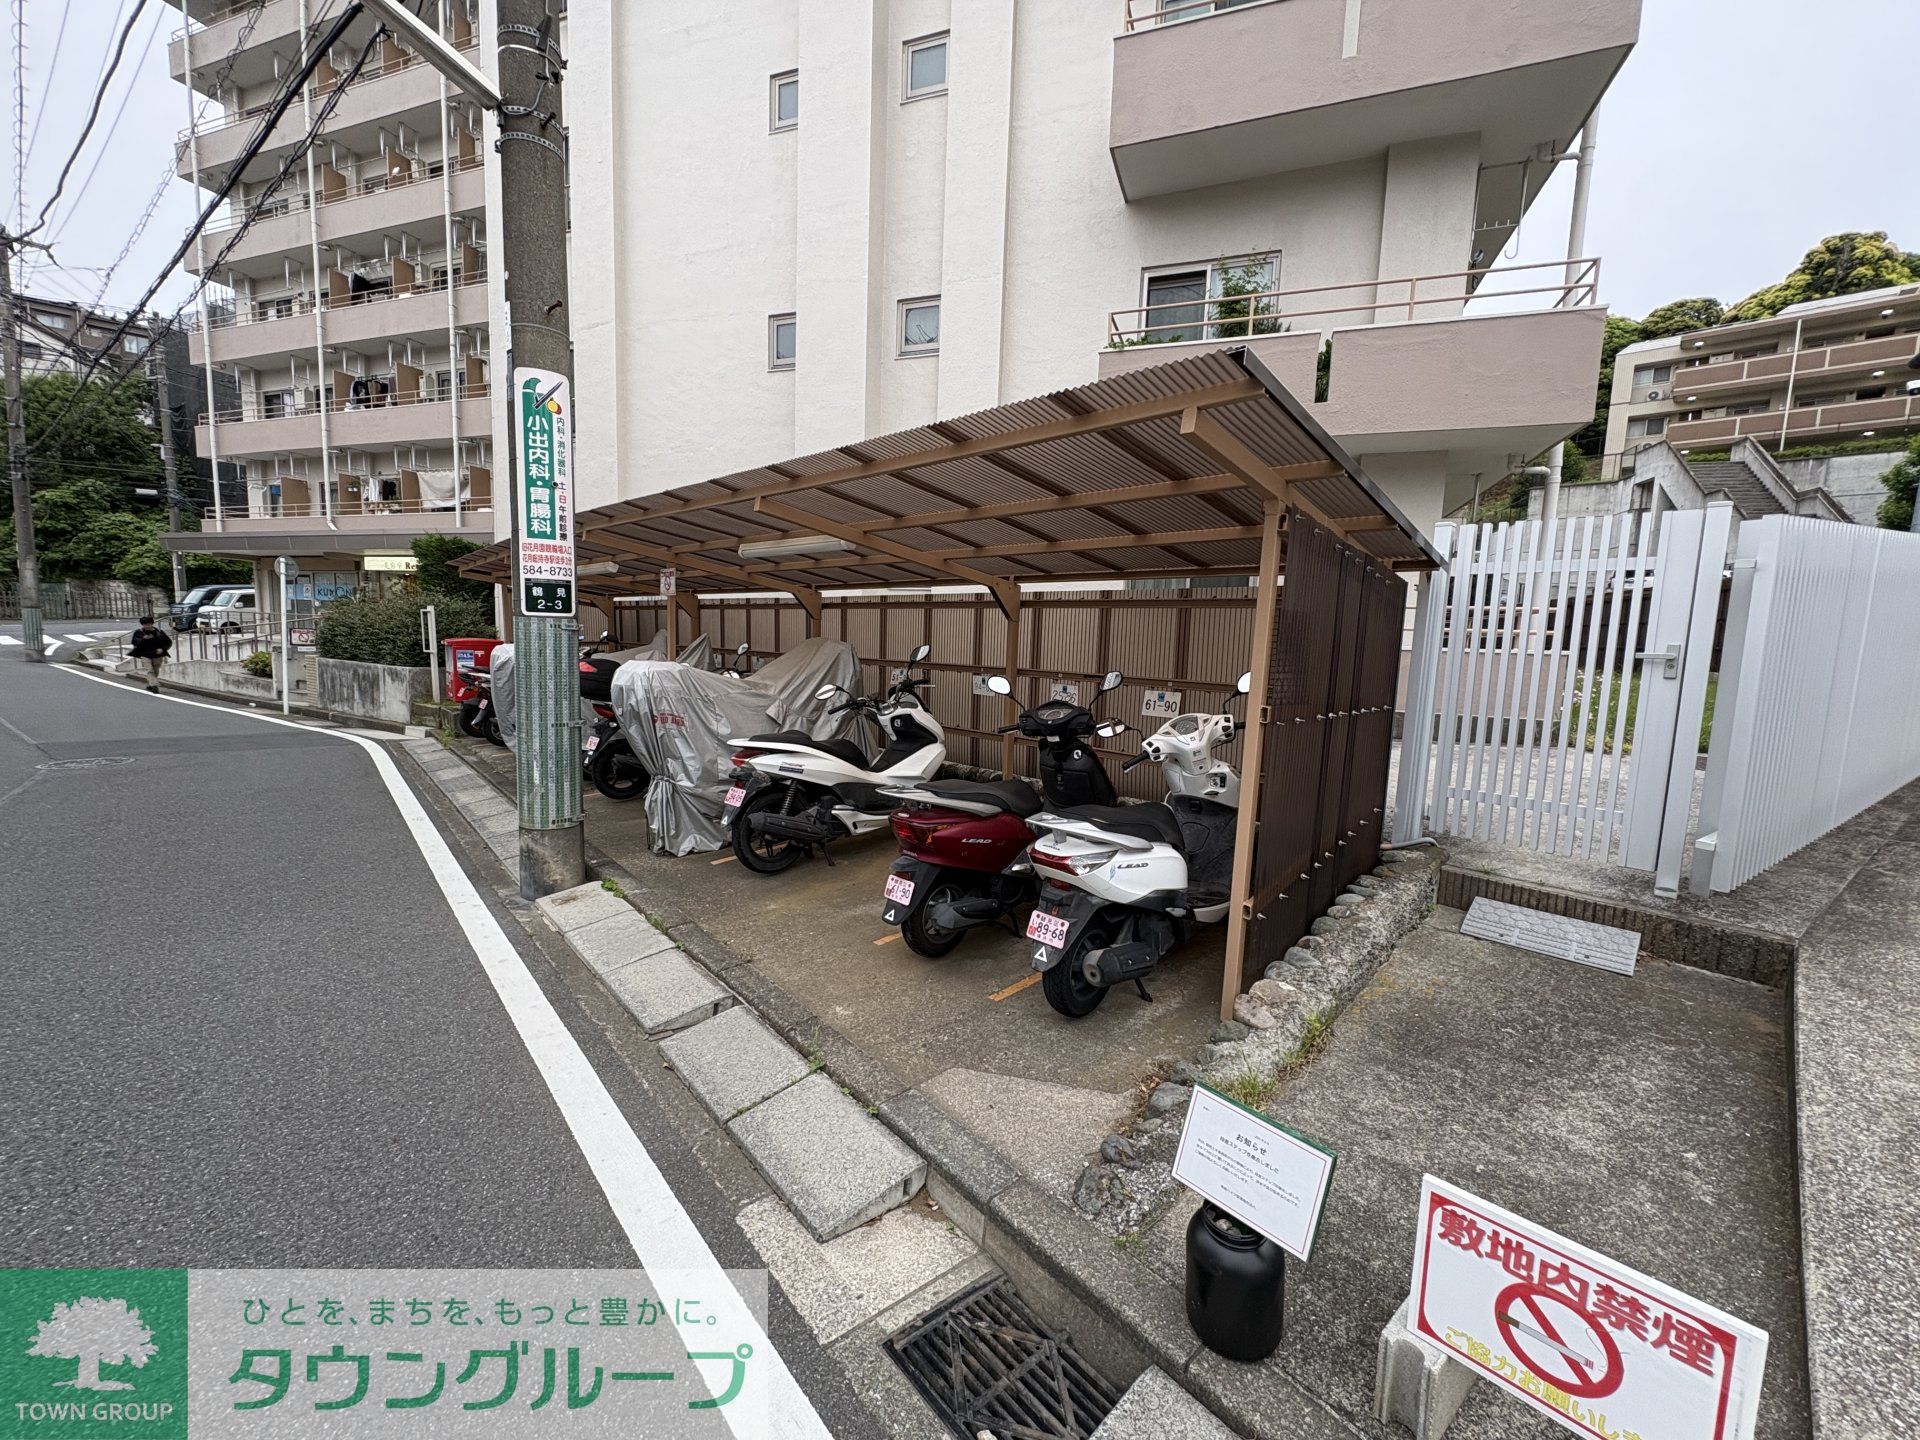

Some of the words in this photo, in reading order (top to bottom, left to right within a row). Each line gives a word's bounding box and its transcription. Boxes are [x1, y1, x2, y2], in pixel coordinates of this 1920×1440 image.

[527, 414, 552, 535] 小出内科・胃腸科
[522, 565, 573, 577] 584-8733
[537, 599, 563, 610] 2-3
[1145, 698, 1178, 713] 61-90
[1117, 862, 1149, 870] LEAD
[890, 884, 911, 899] 61-90
[1036, 921, 1065, 941] 89-68
[1236, 1132, 1267, 1156] お知らせ
[1437, 1204, 1717, 1378] 敷地内禁煙
